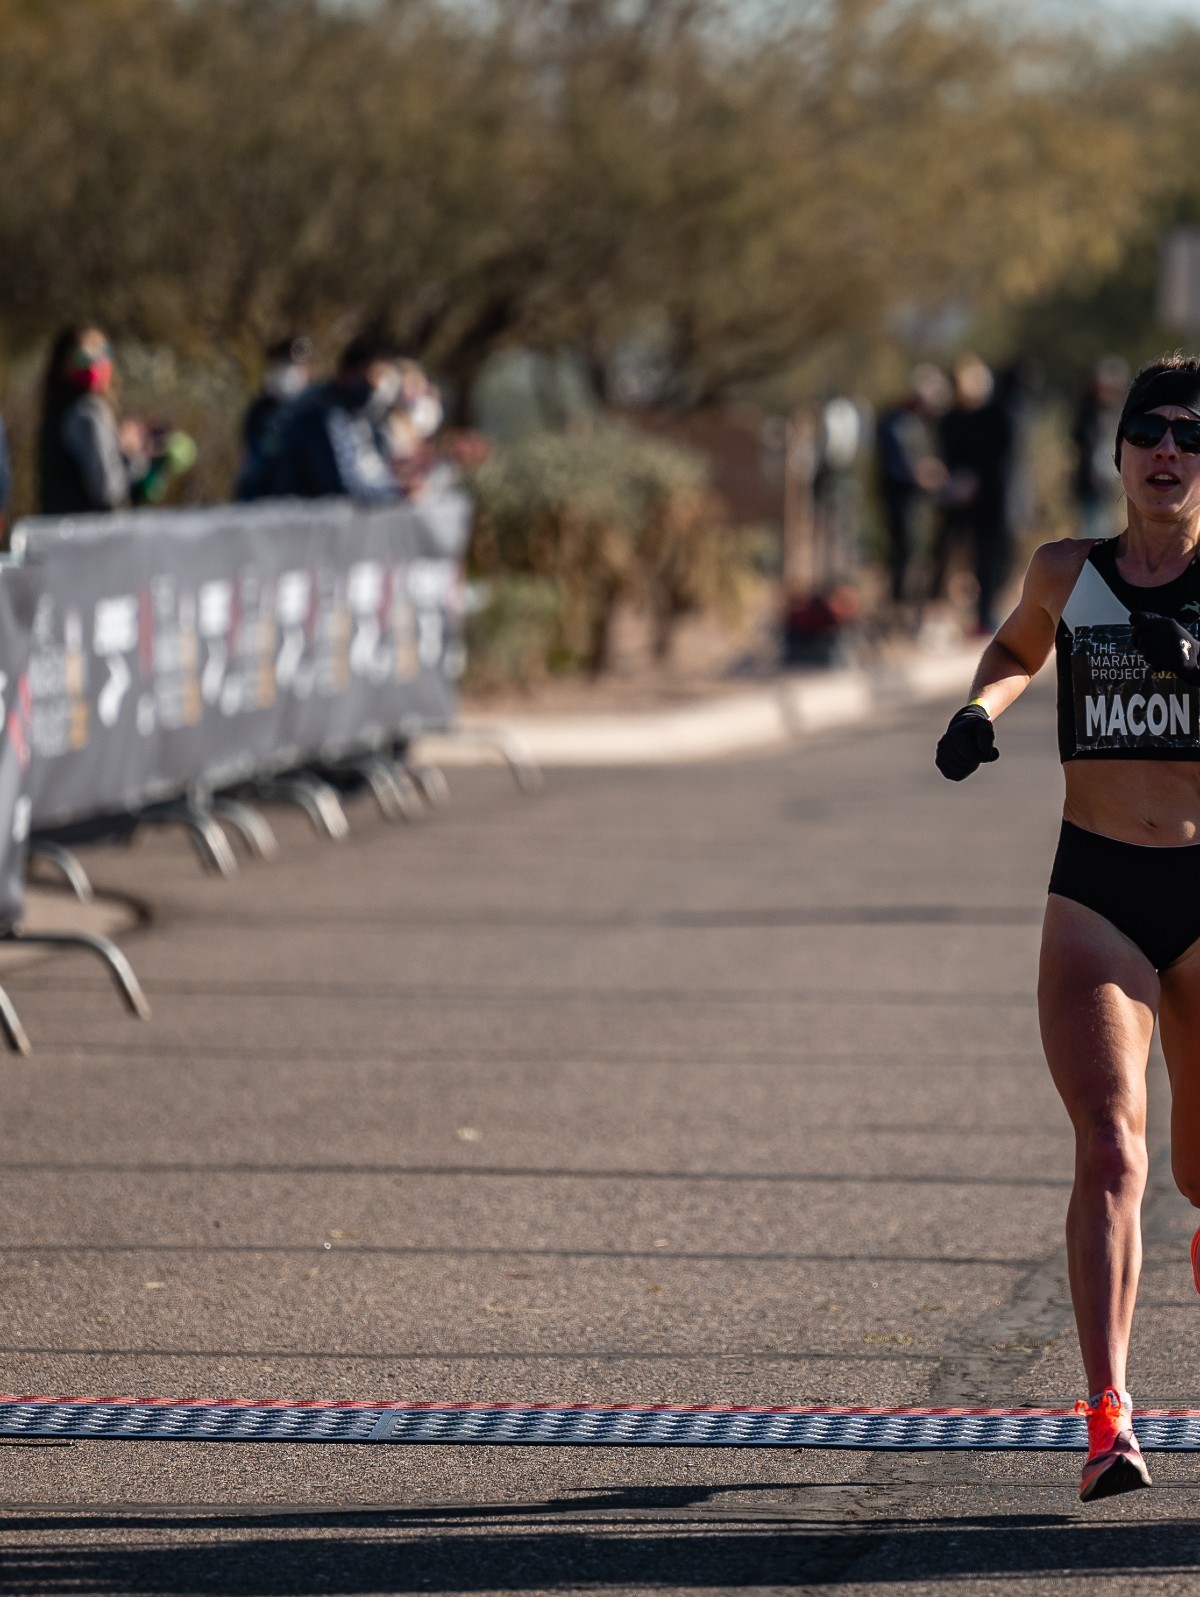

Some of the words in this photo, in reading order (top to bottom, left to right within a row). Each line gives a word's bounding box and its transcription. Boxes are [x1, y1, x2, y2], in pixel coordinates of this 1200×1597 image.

[1092, 643, 1117, 654] THE
[1091, 655, 1147, 667] MARATH
[1091, 668, 1147, 680] PROJECT
[1085, 693, 1190, 737] MACON
